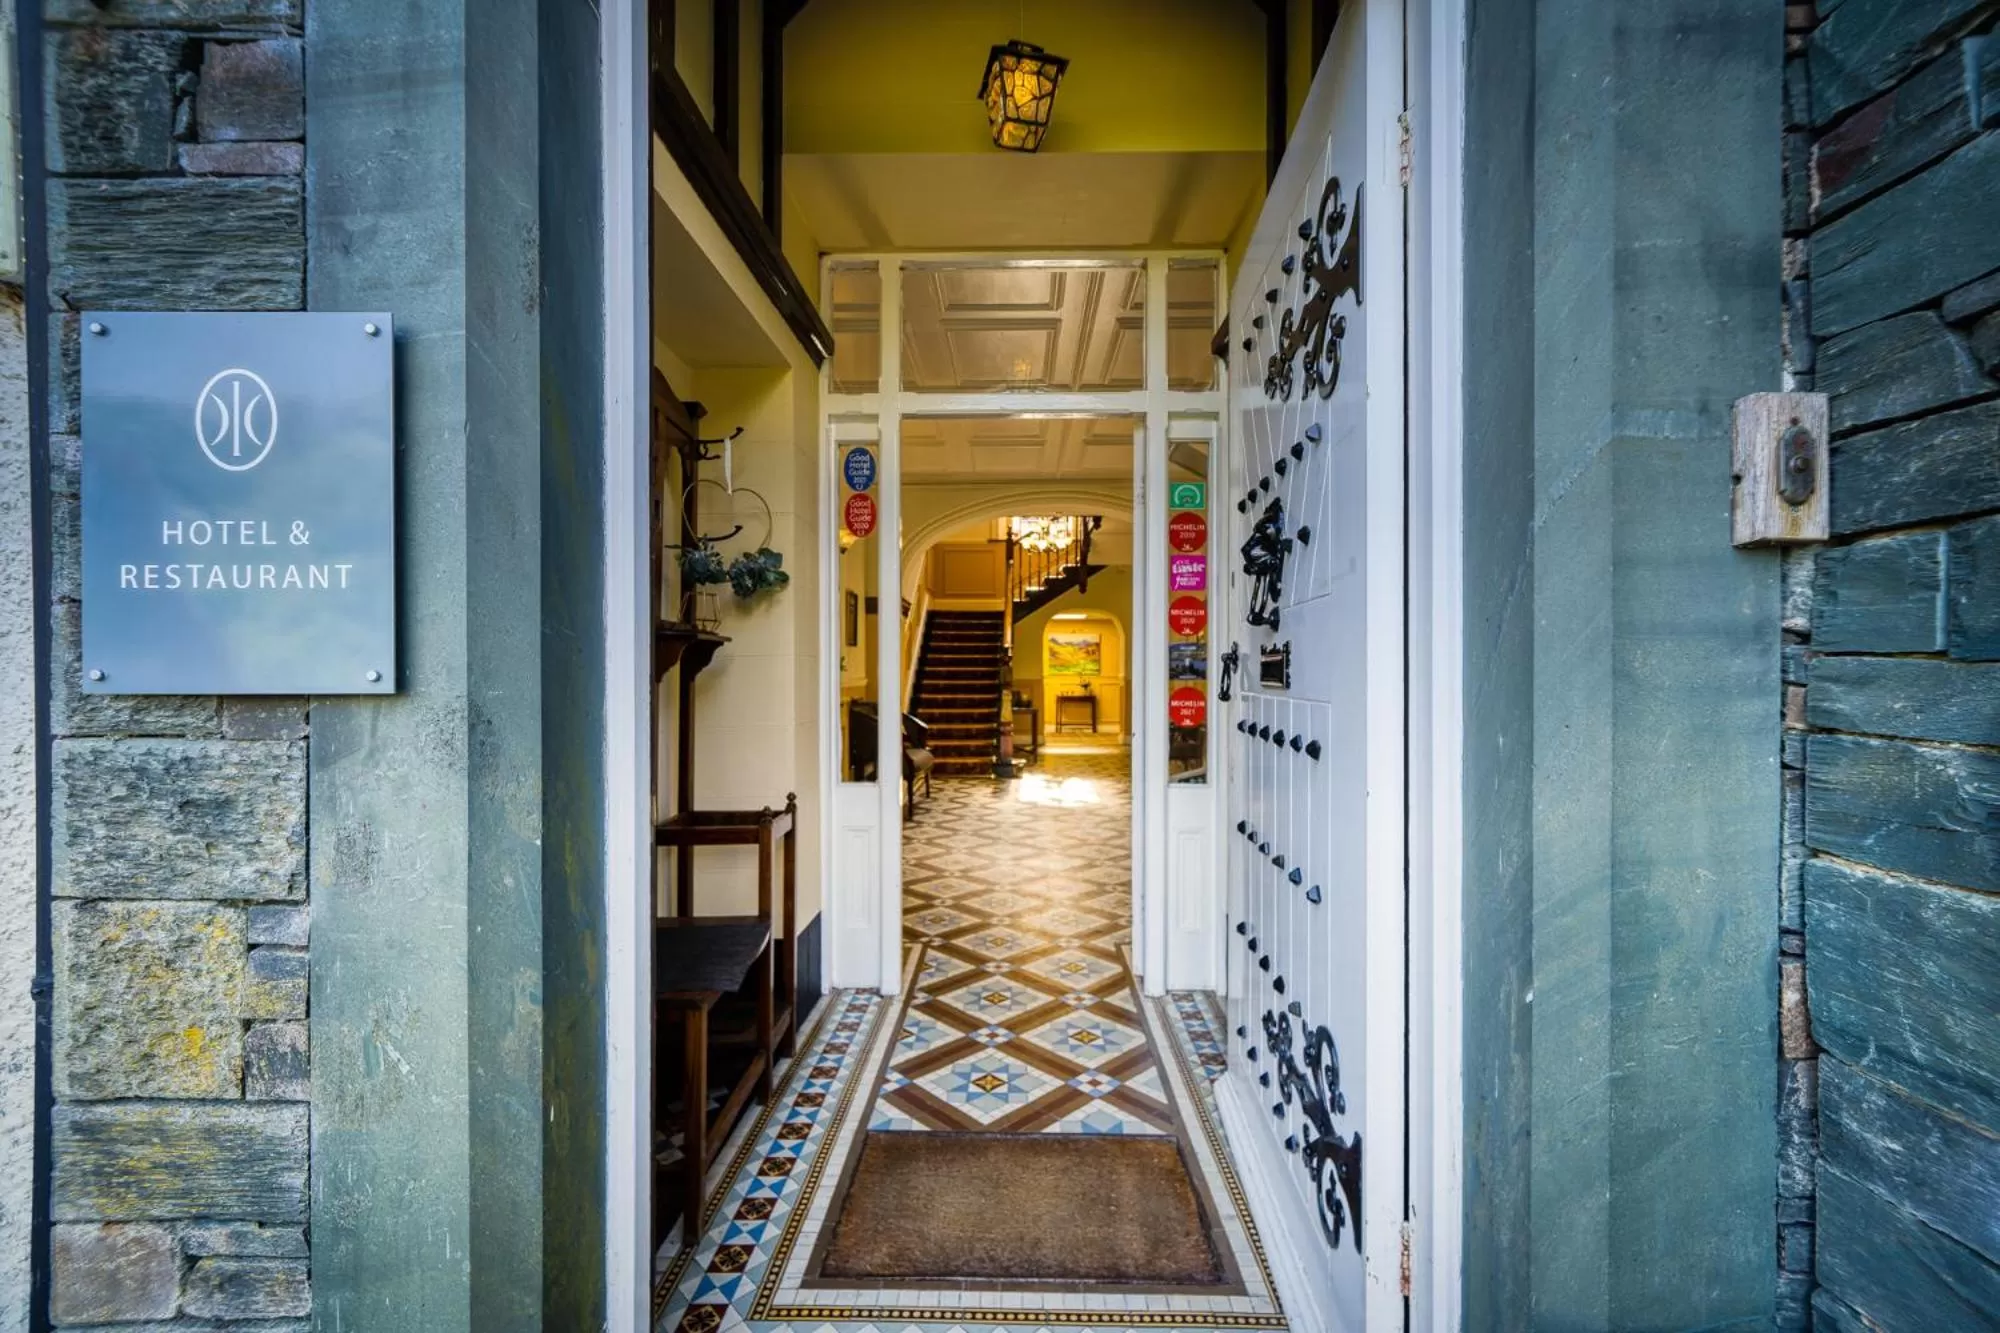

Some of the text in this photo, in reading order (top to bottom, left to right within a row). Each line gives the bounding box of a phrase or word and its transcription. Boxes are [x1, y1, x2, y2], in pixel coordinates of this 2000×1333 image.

[162, 520, 310, 546] HOTEL &
[119, 563, 353, 589] RESTAURANT
